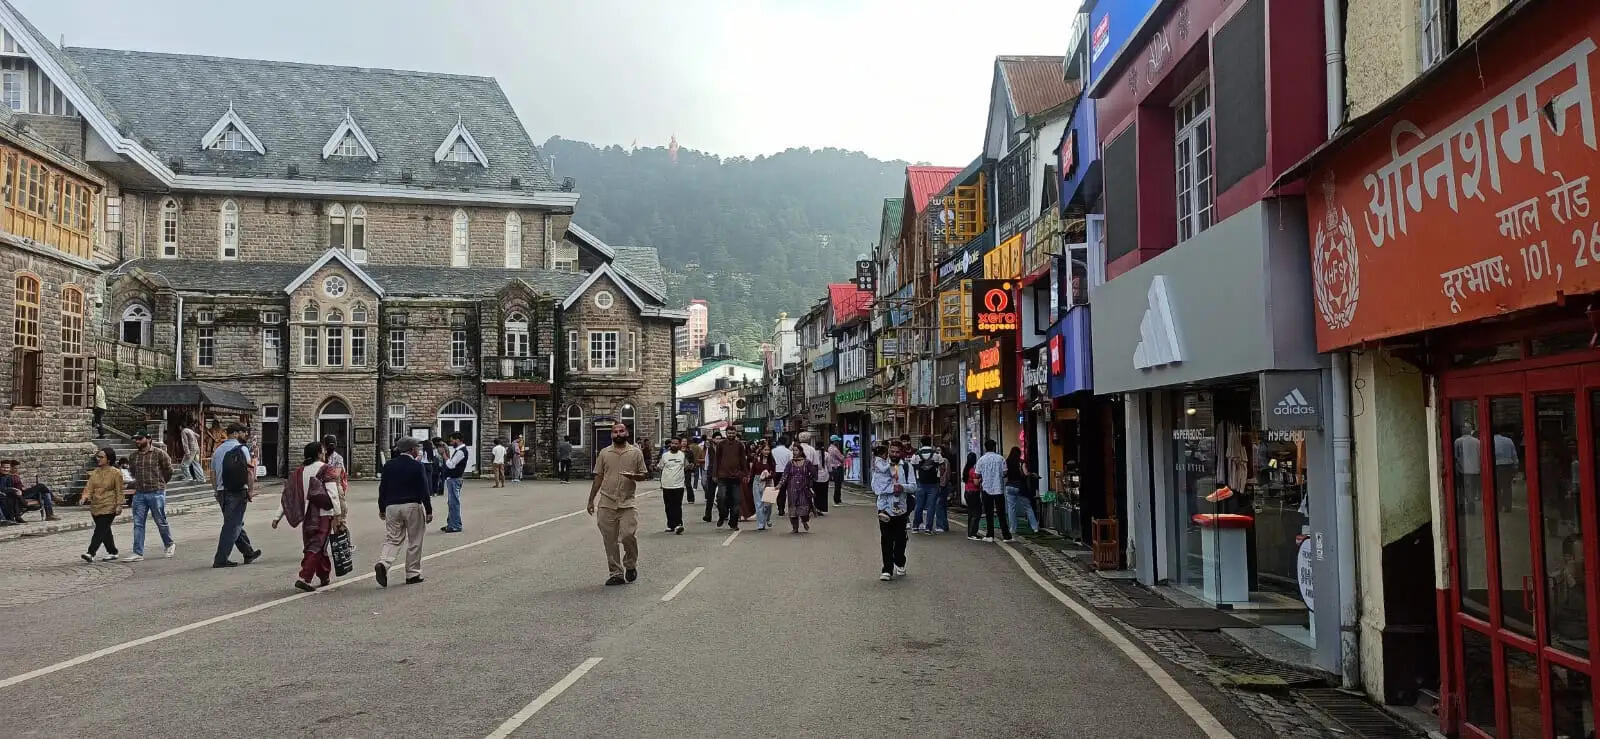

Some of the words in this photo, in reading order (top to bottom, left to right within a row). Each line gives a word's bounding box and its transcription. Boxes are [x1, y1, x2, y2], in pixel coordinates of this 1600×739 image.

[1363, 37, 1598, 248] अग्निशमन
[1496, 197, 1541, 241] माल
[1547, 171, 1590, 224] रोड
[1520, 239, 1562, 284] 101,
[978, 313, 1016, 323] xero
[978, 323, 1016, 332] degrees
[979, 347, 1000, 369] xero
[967, 368, 1001, 399] degrees
[1273, 405, 1315, 415] adidas
